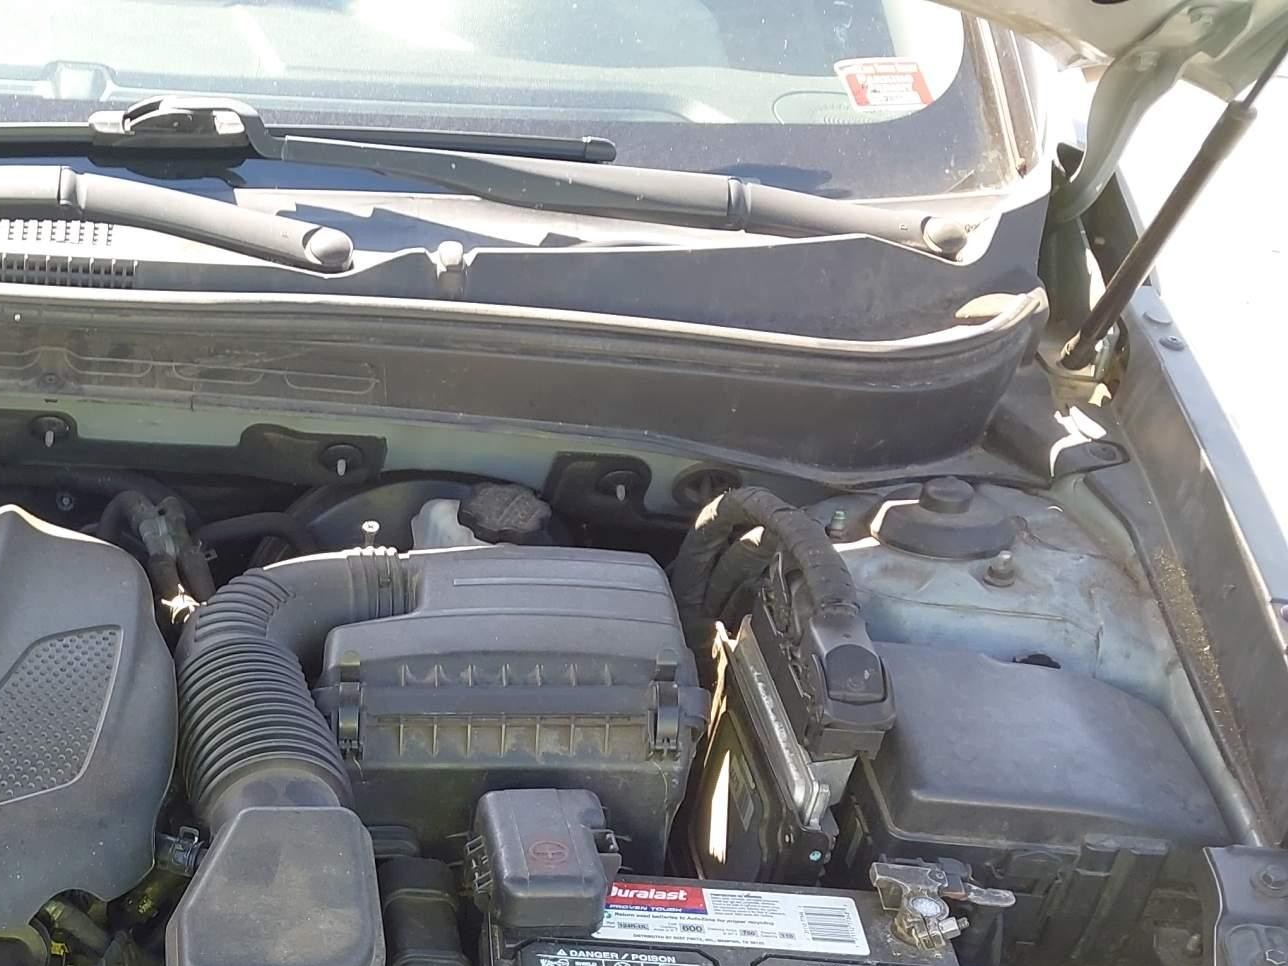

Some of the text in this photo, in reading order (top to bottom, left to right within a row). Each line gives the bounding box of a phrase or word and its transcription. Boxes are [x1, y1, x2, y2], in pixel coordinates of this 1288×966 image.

[681, 924, 703, 932] 600
[570, 950, 618, 960] DANGER
[631, 953, 676, 963] POISON
